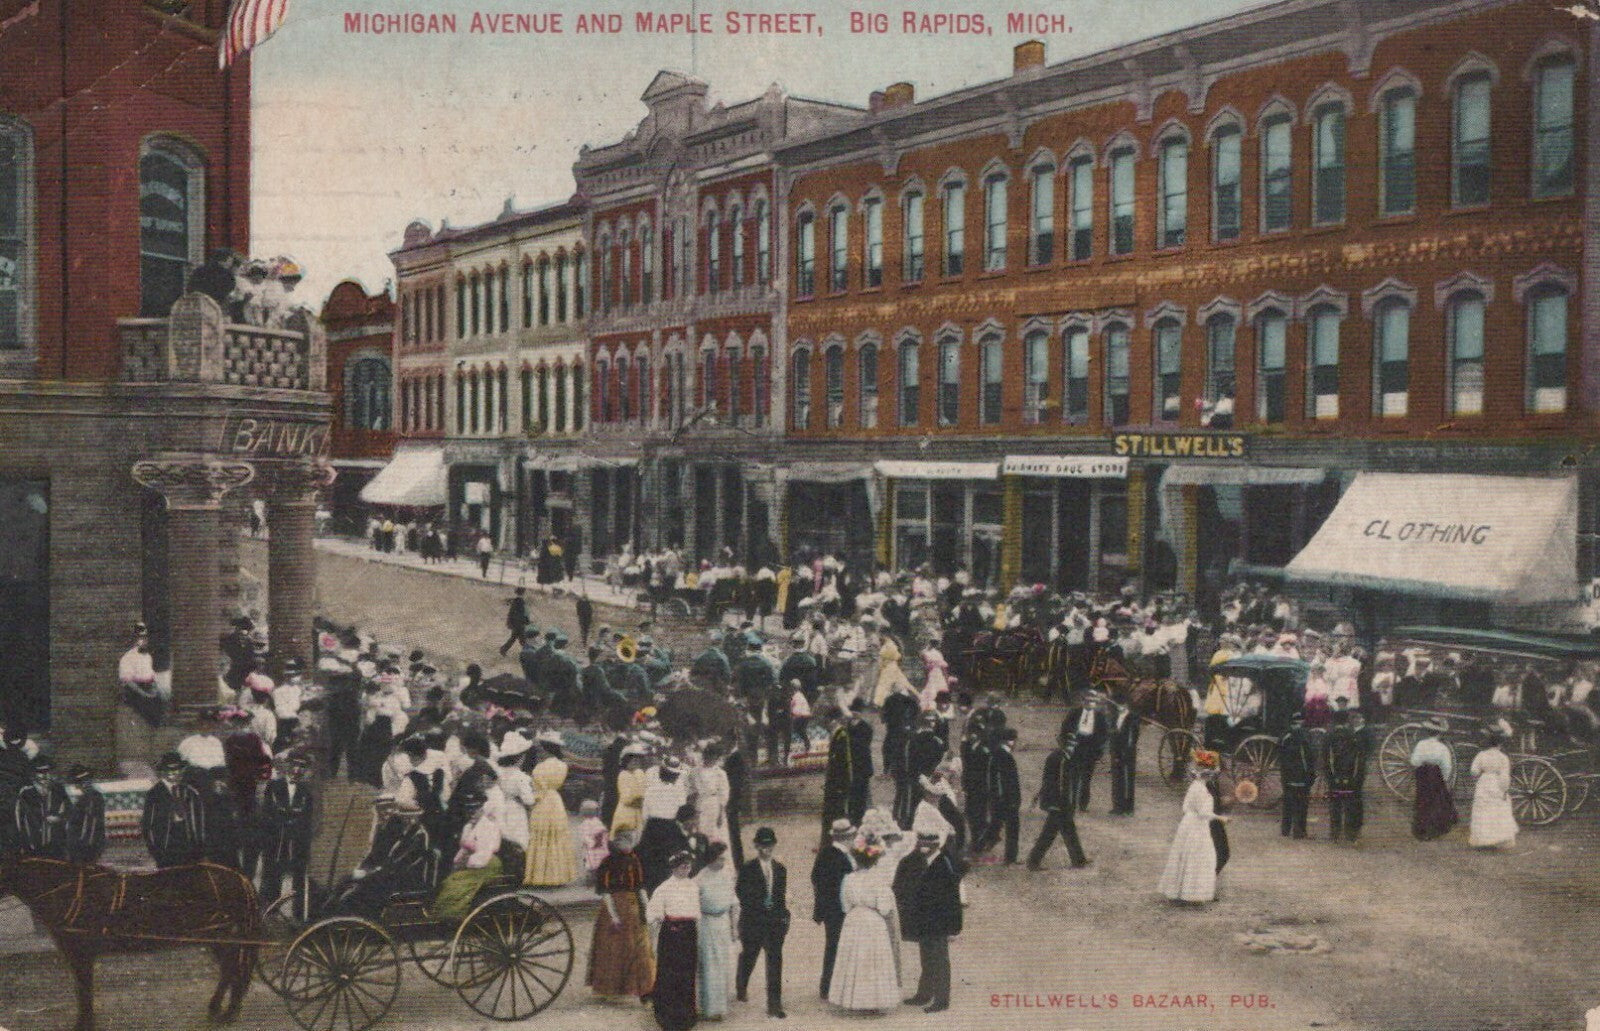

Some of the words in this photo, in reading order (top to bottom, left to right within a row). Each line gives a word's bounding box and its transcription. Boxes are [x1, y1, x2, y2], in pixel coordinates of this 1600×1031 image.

[232, 418, 319, 454] BANK
[1115, 434, 1243, 456] STILLWELL'S
[1363, 519, 1491, 545] CLOTHING
